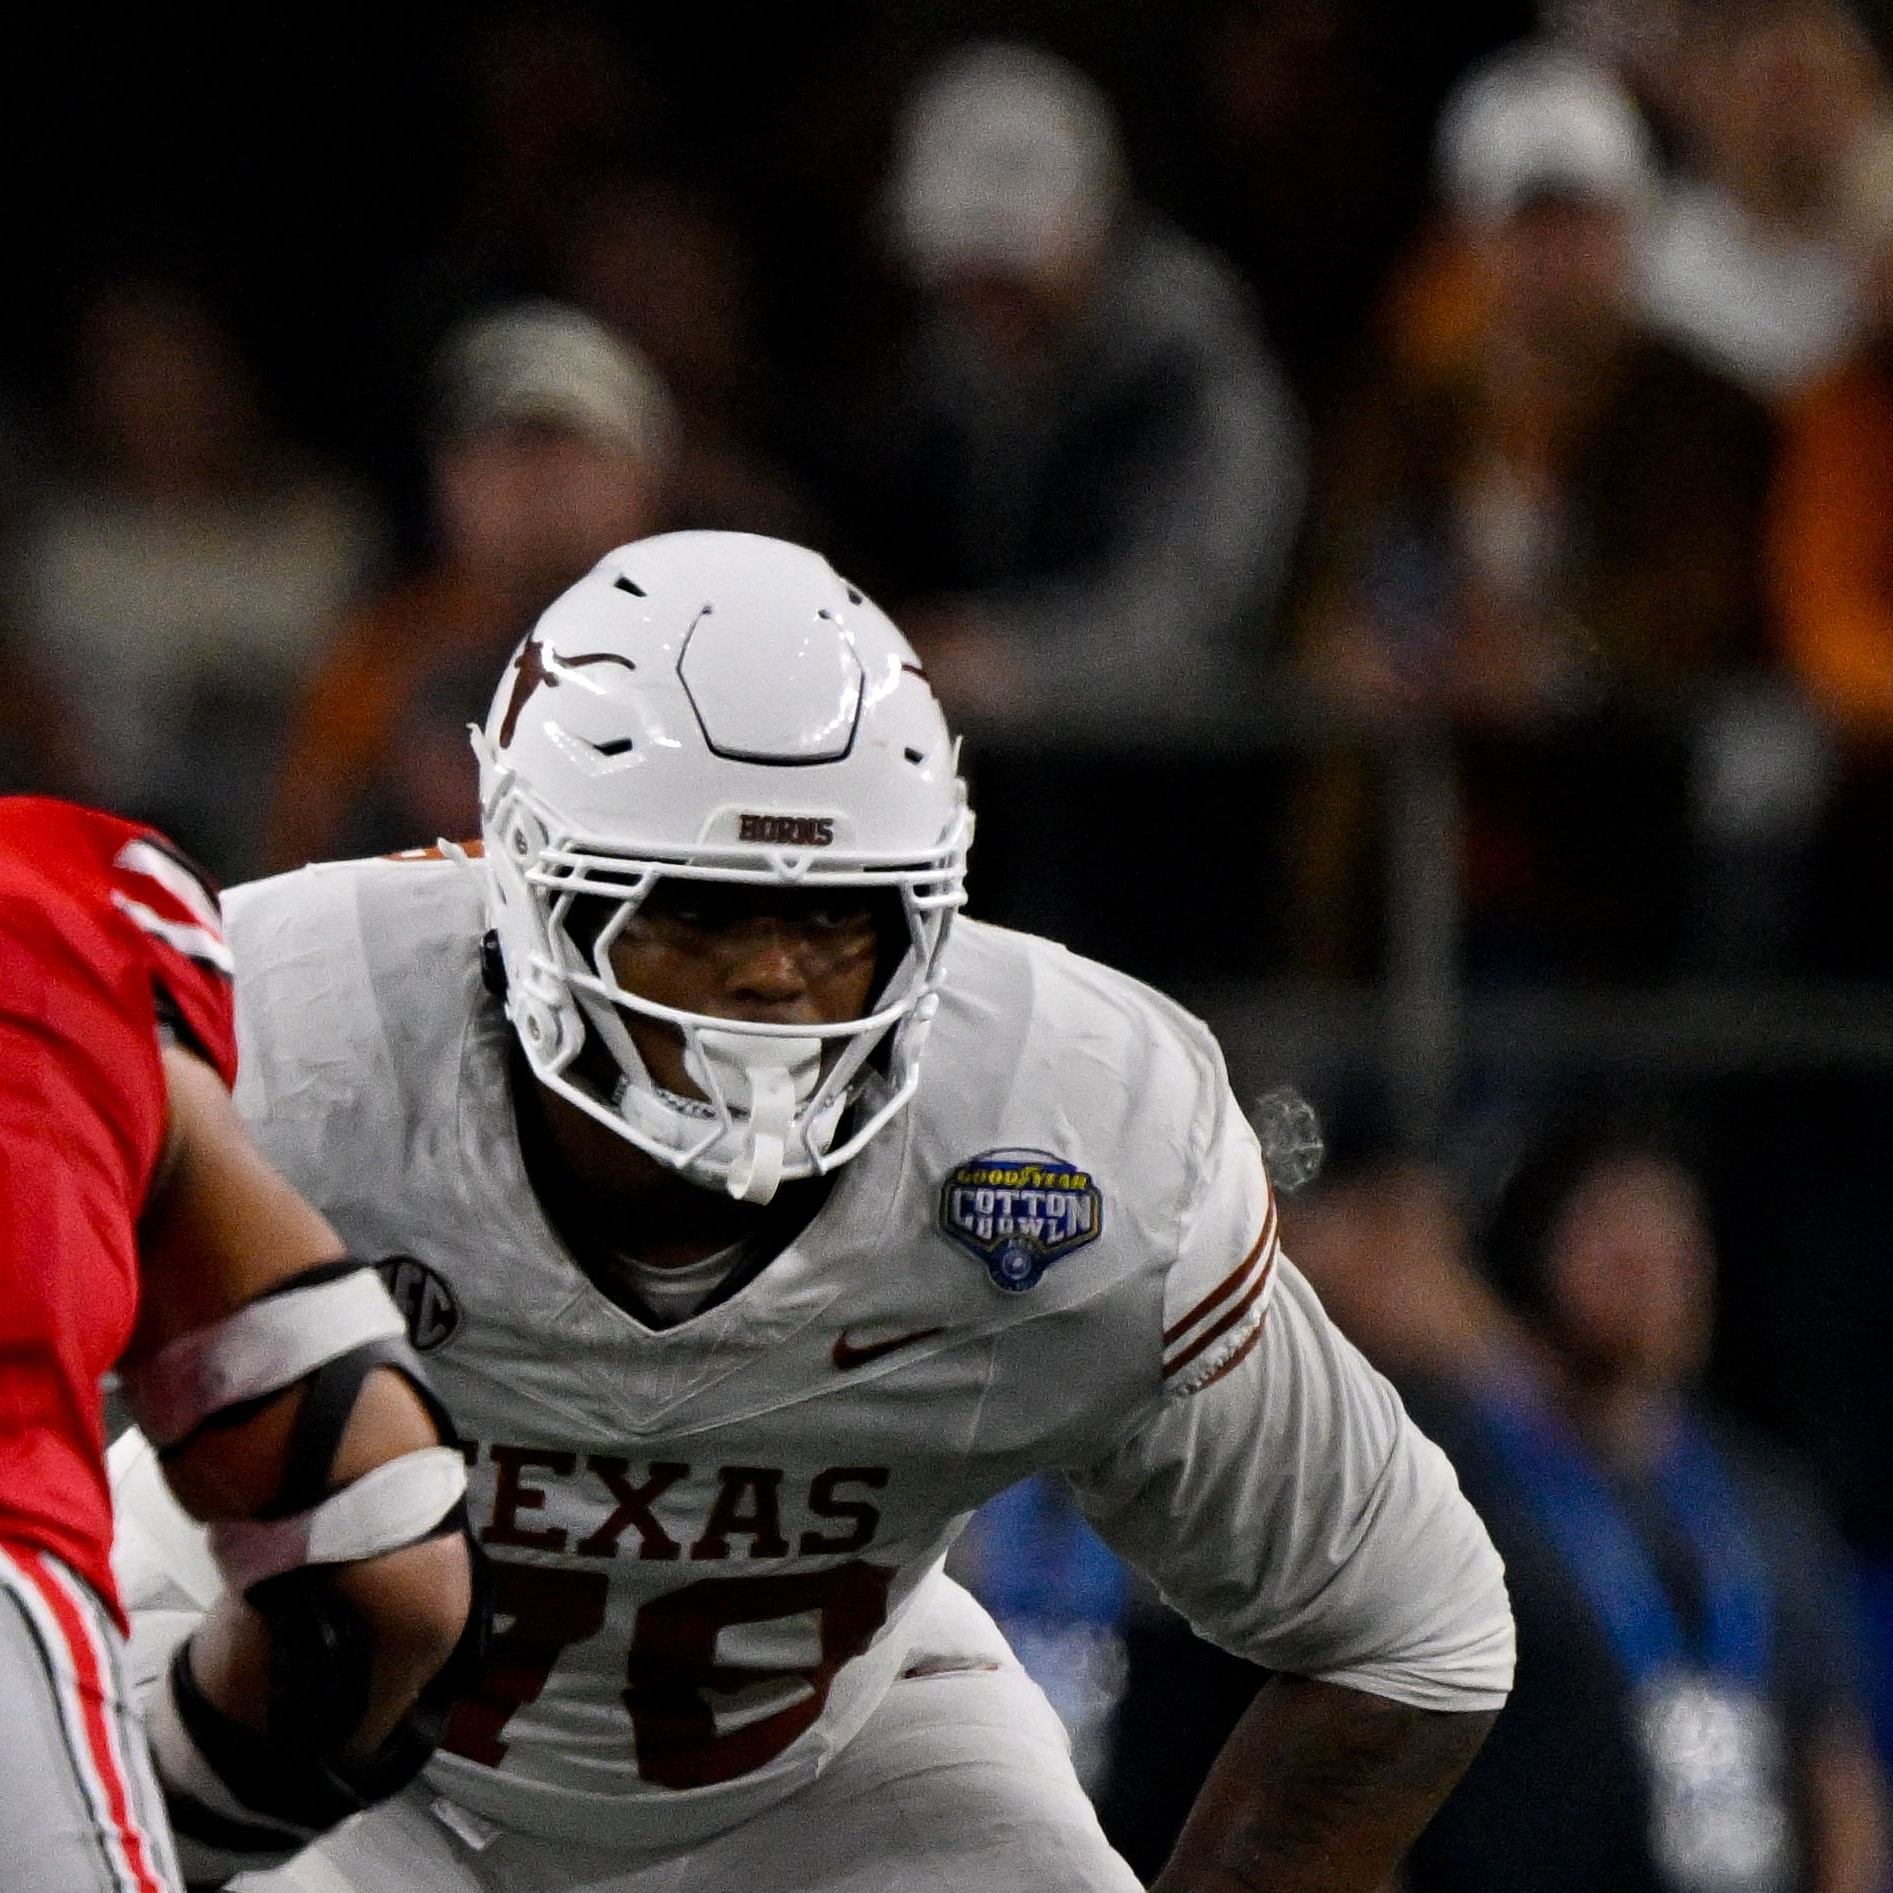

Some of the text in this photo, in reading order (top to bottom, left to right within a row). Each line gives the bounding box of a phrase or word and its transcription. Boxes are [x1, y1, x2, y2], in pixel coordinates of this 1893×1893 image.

[739, 814, 834, 846] HORNS
[957, 1167, 1087, 1190] GOODYEAR
[951, 1187, 1092, 1237] COTTON
[975, 1216, 1065, 1244] BOWL
[456, 1440, 890, 1560] EXAS
